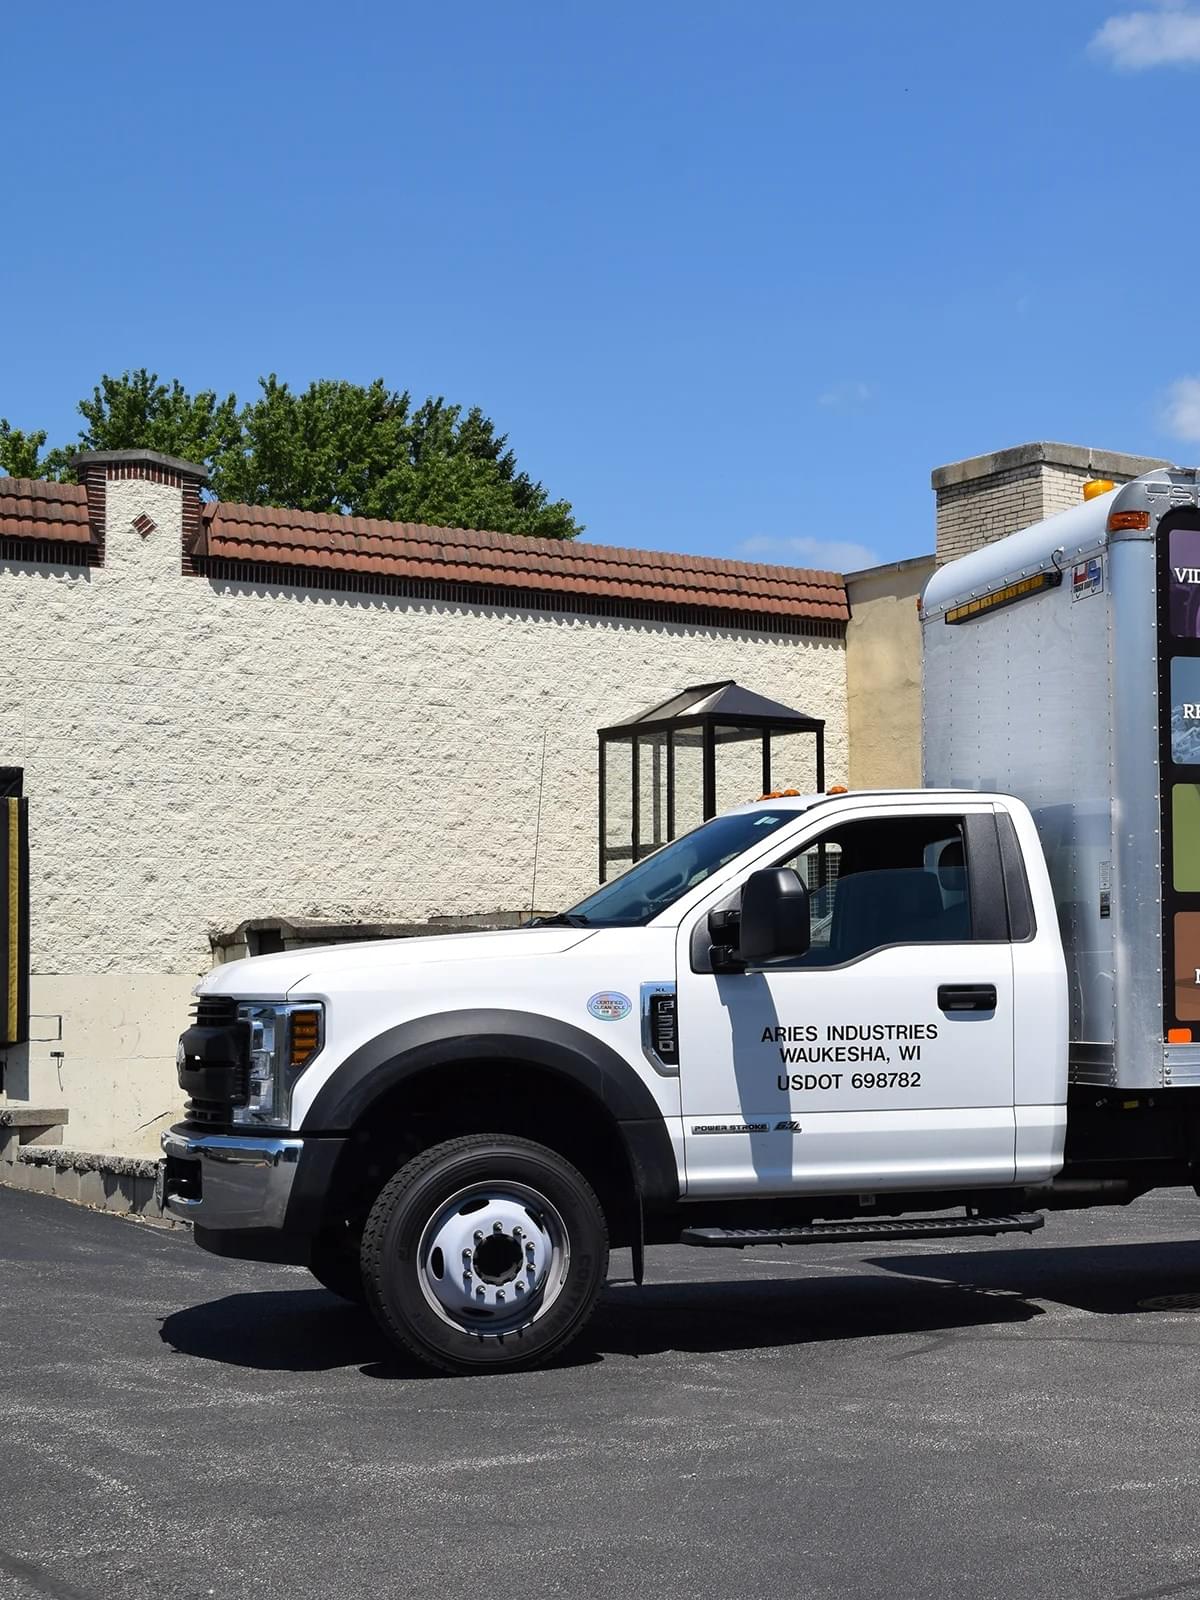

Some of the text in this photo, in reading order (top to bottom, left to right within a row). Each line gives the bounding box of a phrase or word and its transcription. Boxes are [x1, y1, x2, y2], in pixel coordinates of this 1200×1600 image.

[761, 1024, 938, 1043] ARIES INDUSTRIES
[779, 1045, 921, 1065] WAUKESHA, WI
[777, 1072, 921, 1091] USDOT 698782
[729, 1123, 768, 1131] STROKE
